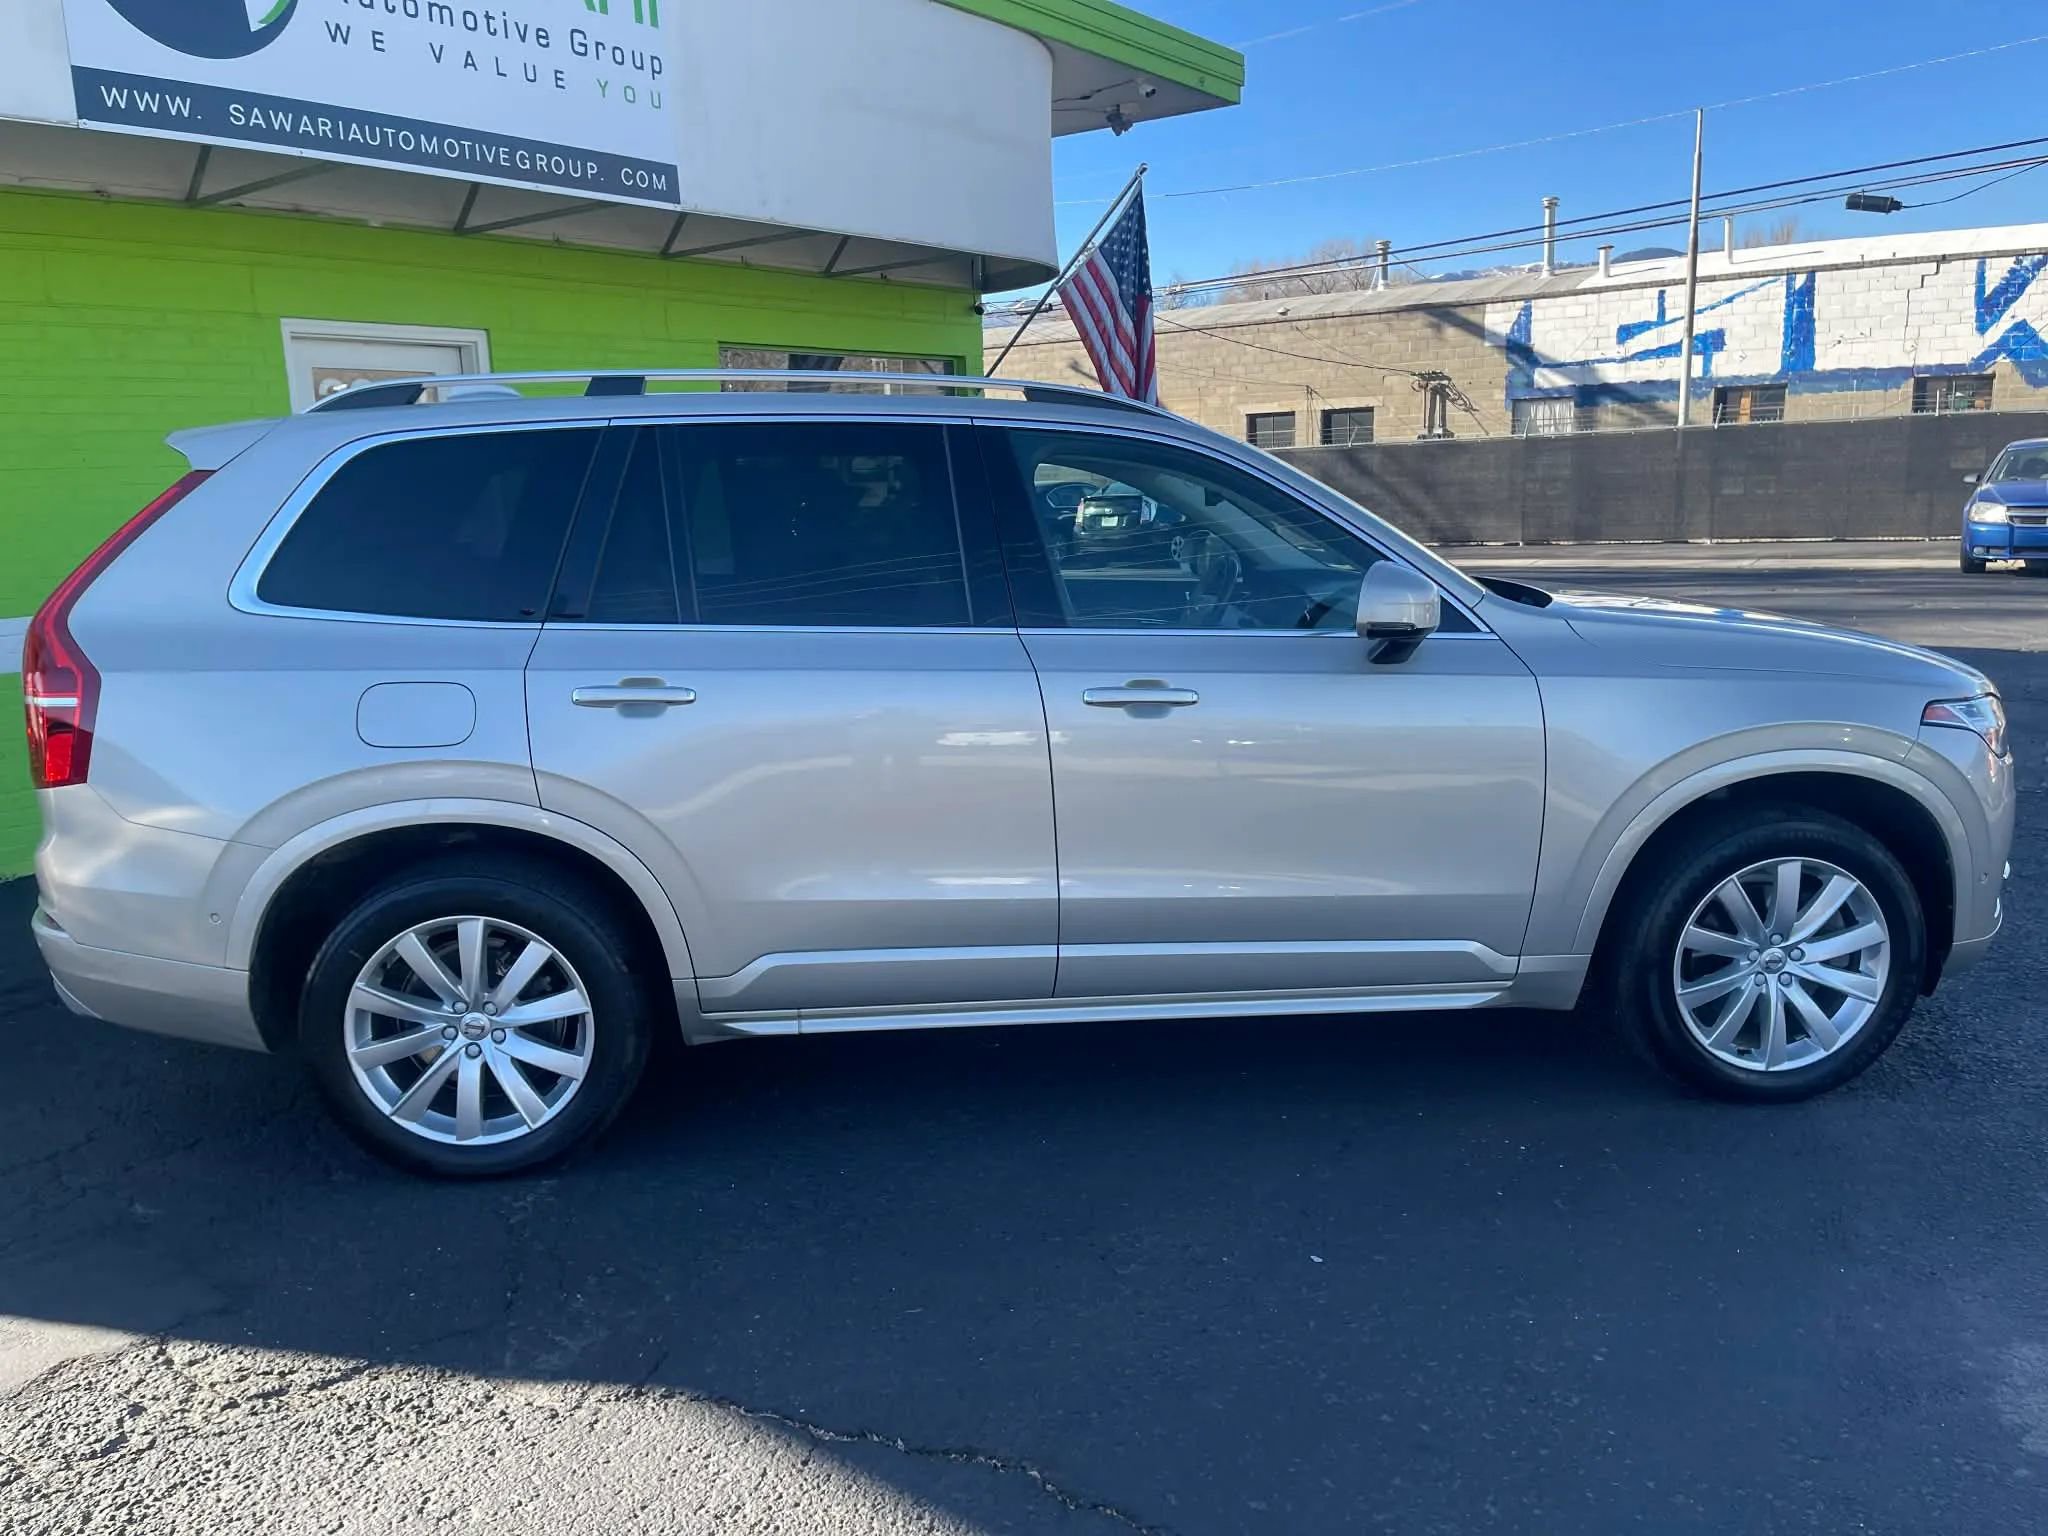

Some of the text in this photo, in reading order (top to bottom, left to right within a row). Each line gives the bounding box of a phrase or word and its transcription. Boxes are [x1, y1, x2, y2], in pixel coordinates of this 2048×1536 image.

[324, 20, 662, 110] WE VALUE YOU
[570, 28, 663, 81] Group
[100, 85, 667, 191] WWW. SAWARIAUTOMOTIVEGROUP. COM
